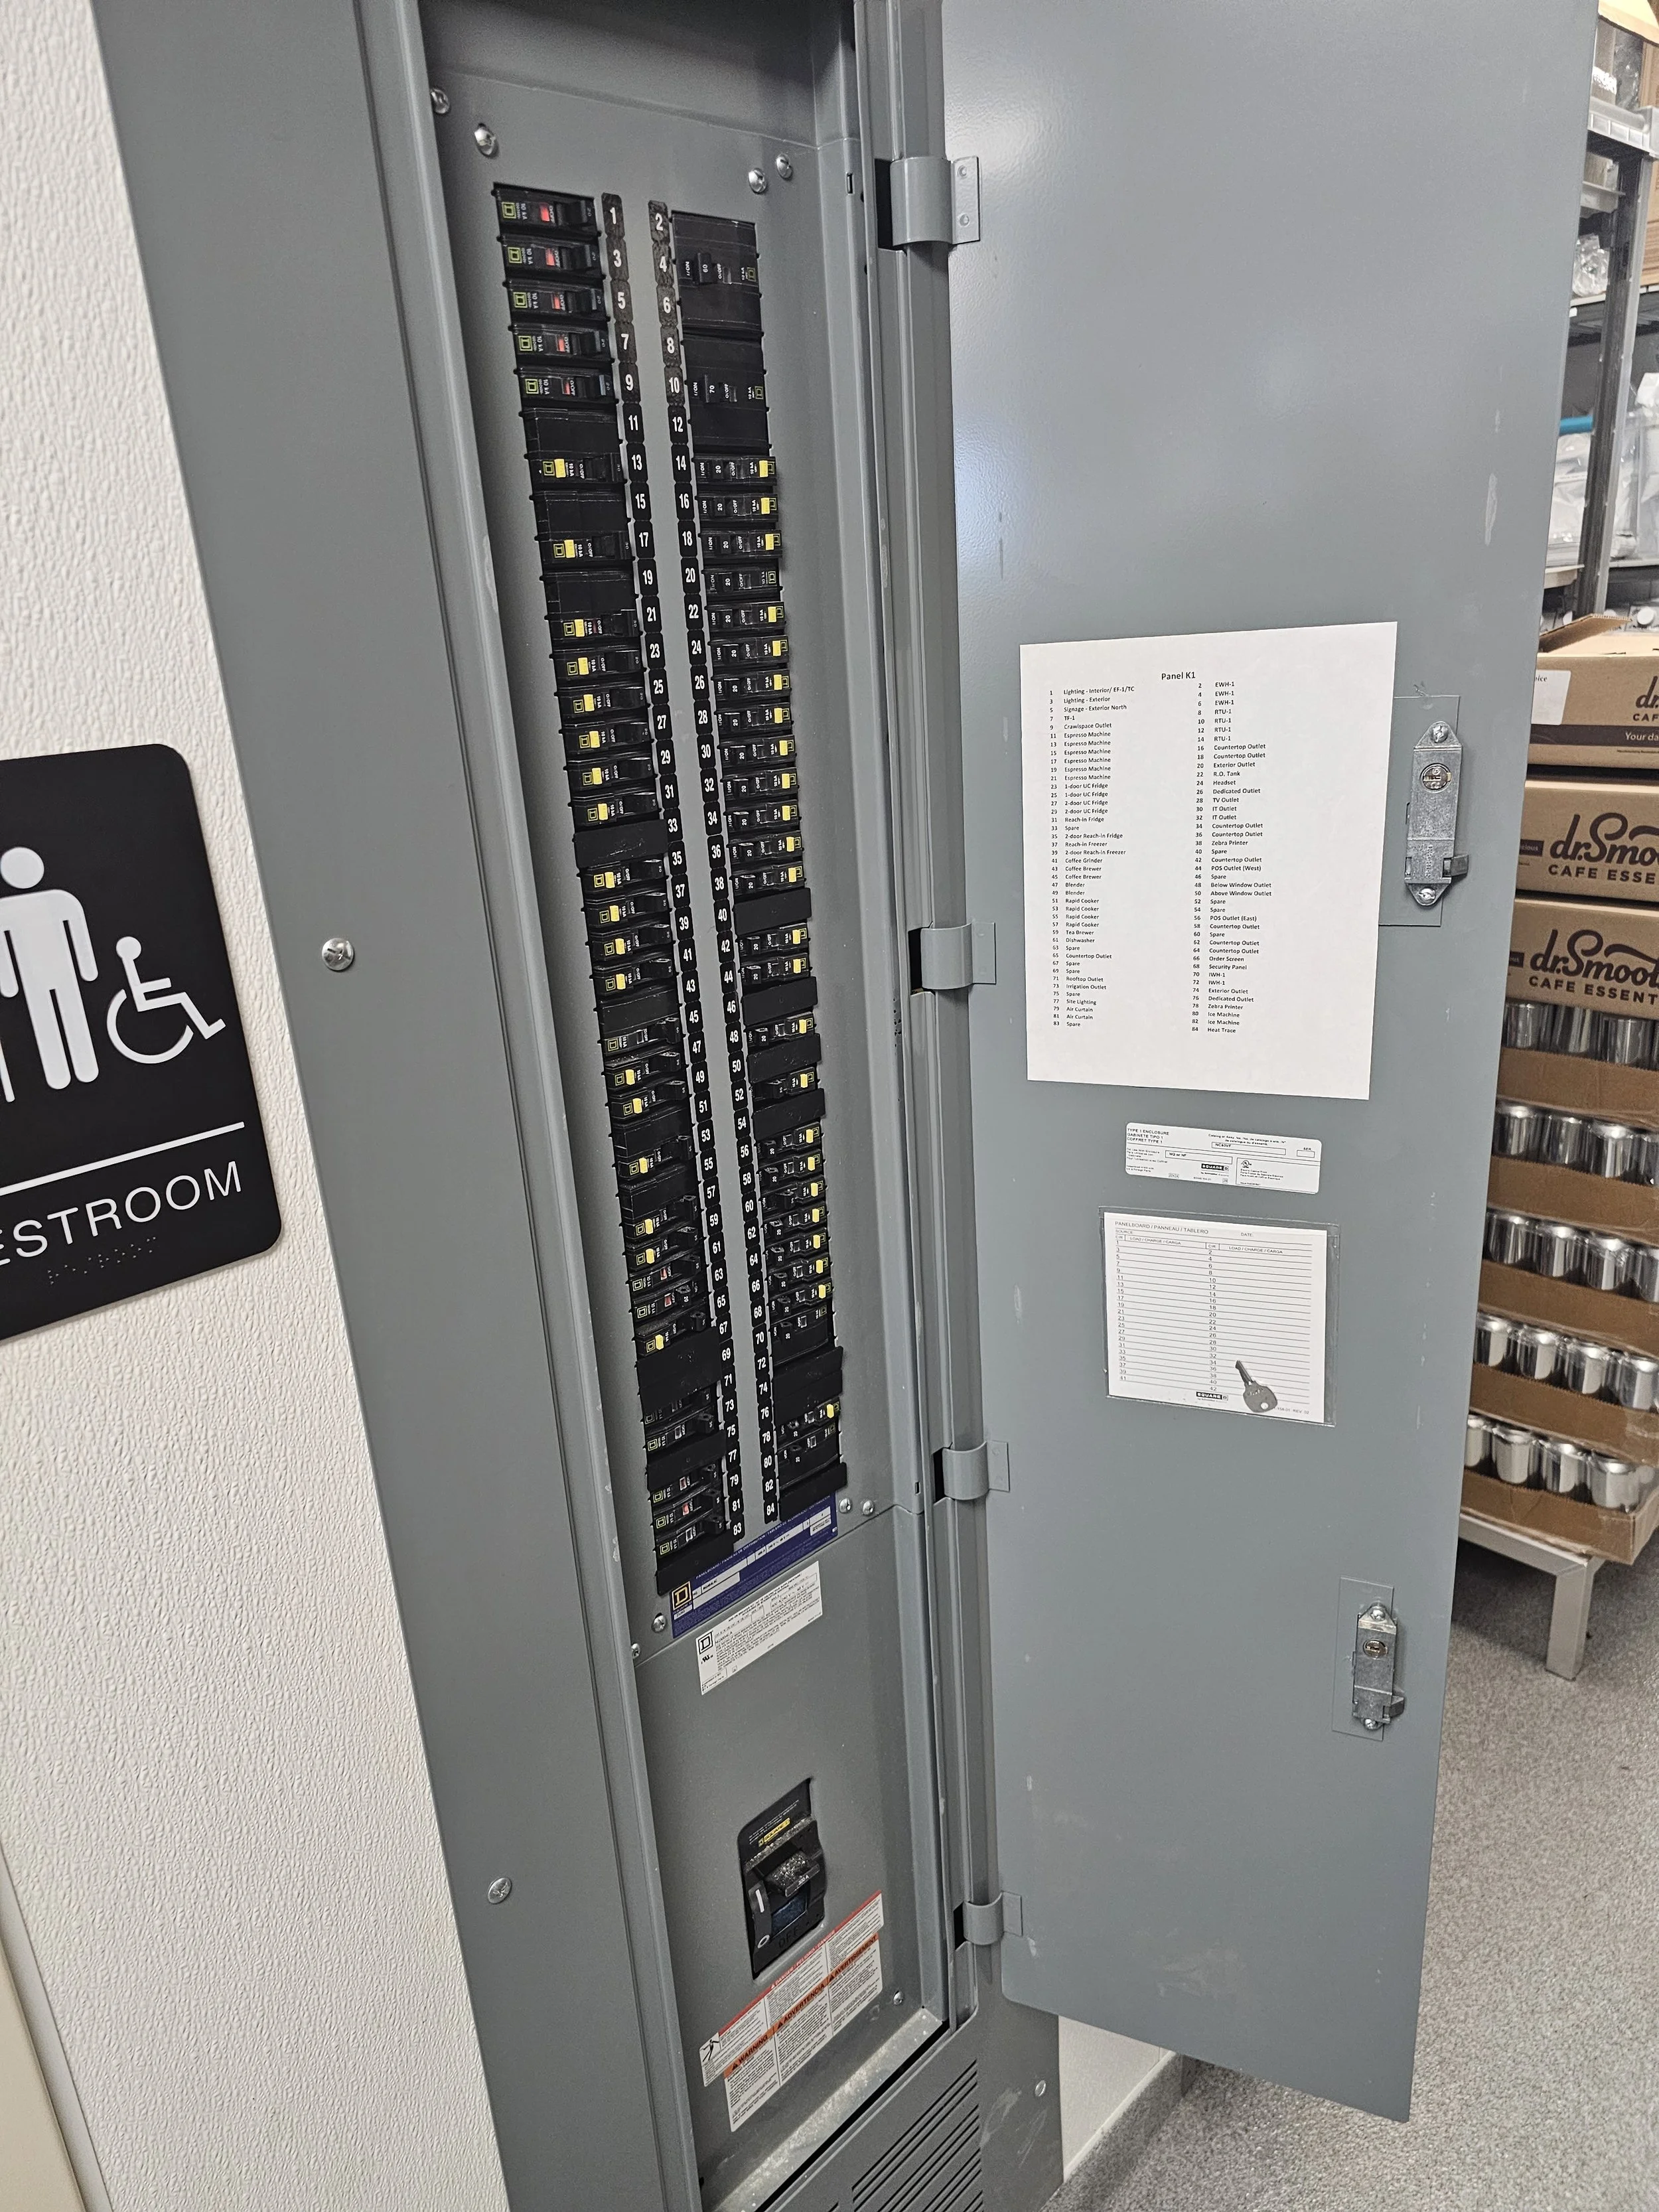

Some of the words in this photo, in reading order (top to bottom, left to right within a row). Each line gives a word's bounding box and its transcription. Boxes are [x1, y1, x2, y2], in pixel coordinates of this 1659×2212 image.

[610, 207, 616, 224] 1
[656, 213, 663, 231] 2
[613, 250, 621, 267] 3
[660, 255, 666, 272] 4
[703, 264, 708, 273] 60
[618, 292, 625, 309] 5
[664, 297, 671, 313] 6
[621, 334, 629, 350] 7
[667, 337, 674, 353] 8
[669, 377, 680, 393] 10
[632, 455, 642, 470] 13
[676, 455, 686, 470] 14
[643, 570, 652, 585] 19
[689, 605, 699, 619] 22
[1161, 672, 1183, 680] Panel
[1626, 732, 1644, 741] Your
[665, 784, 674, 798] 31
[1550, 812, 1659, 867] dr.Smo
[711, 844, 721, 858] 36
[1548, 864, 1598, 879] CAFE
[1607, 869, 1656, 885] ESSE
[1528, 976, 1575, 993] CAFE
[1584, 984, 1659, 1005] ESSENT
[693, 1041, 701, 1053] 47
[735, 1088, 744, 1101] 52
[710, 1213, 718, 1226] 59
[752, 1280, 760, 1292] 66
[725, 1399, 734, 1412] 73
[764, 1455, 772, 1468] 80
[767, 1503, 774, 1515] 84
[733, 1522, 741, 1535] 83
[739, 2035, 768, 2063] WARNING
[784, 1983, 825, 2022] ADVERTENCIA
[834, 1934, 877, 1976] AVERTISSEMENT
